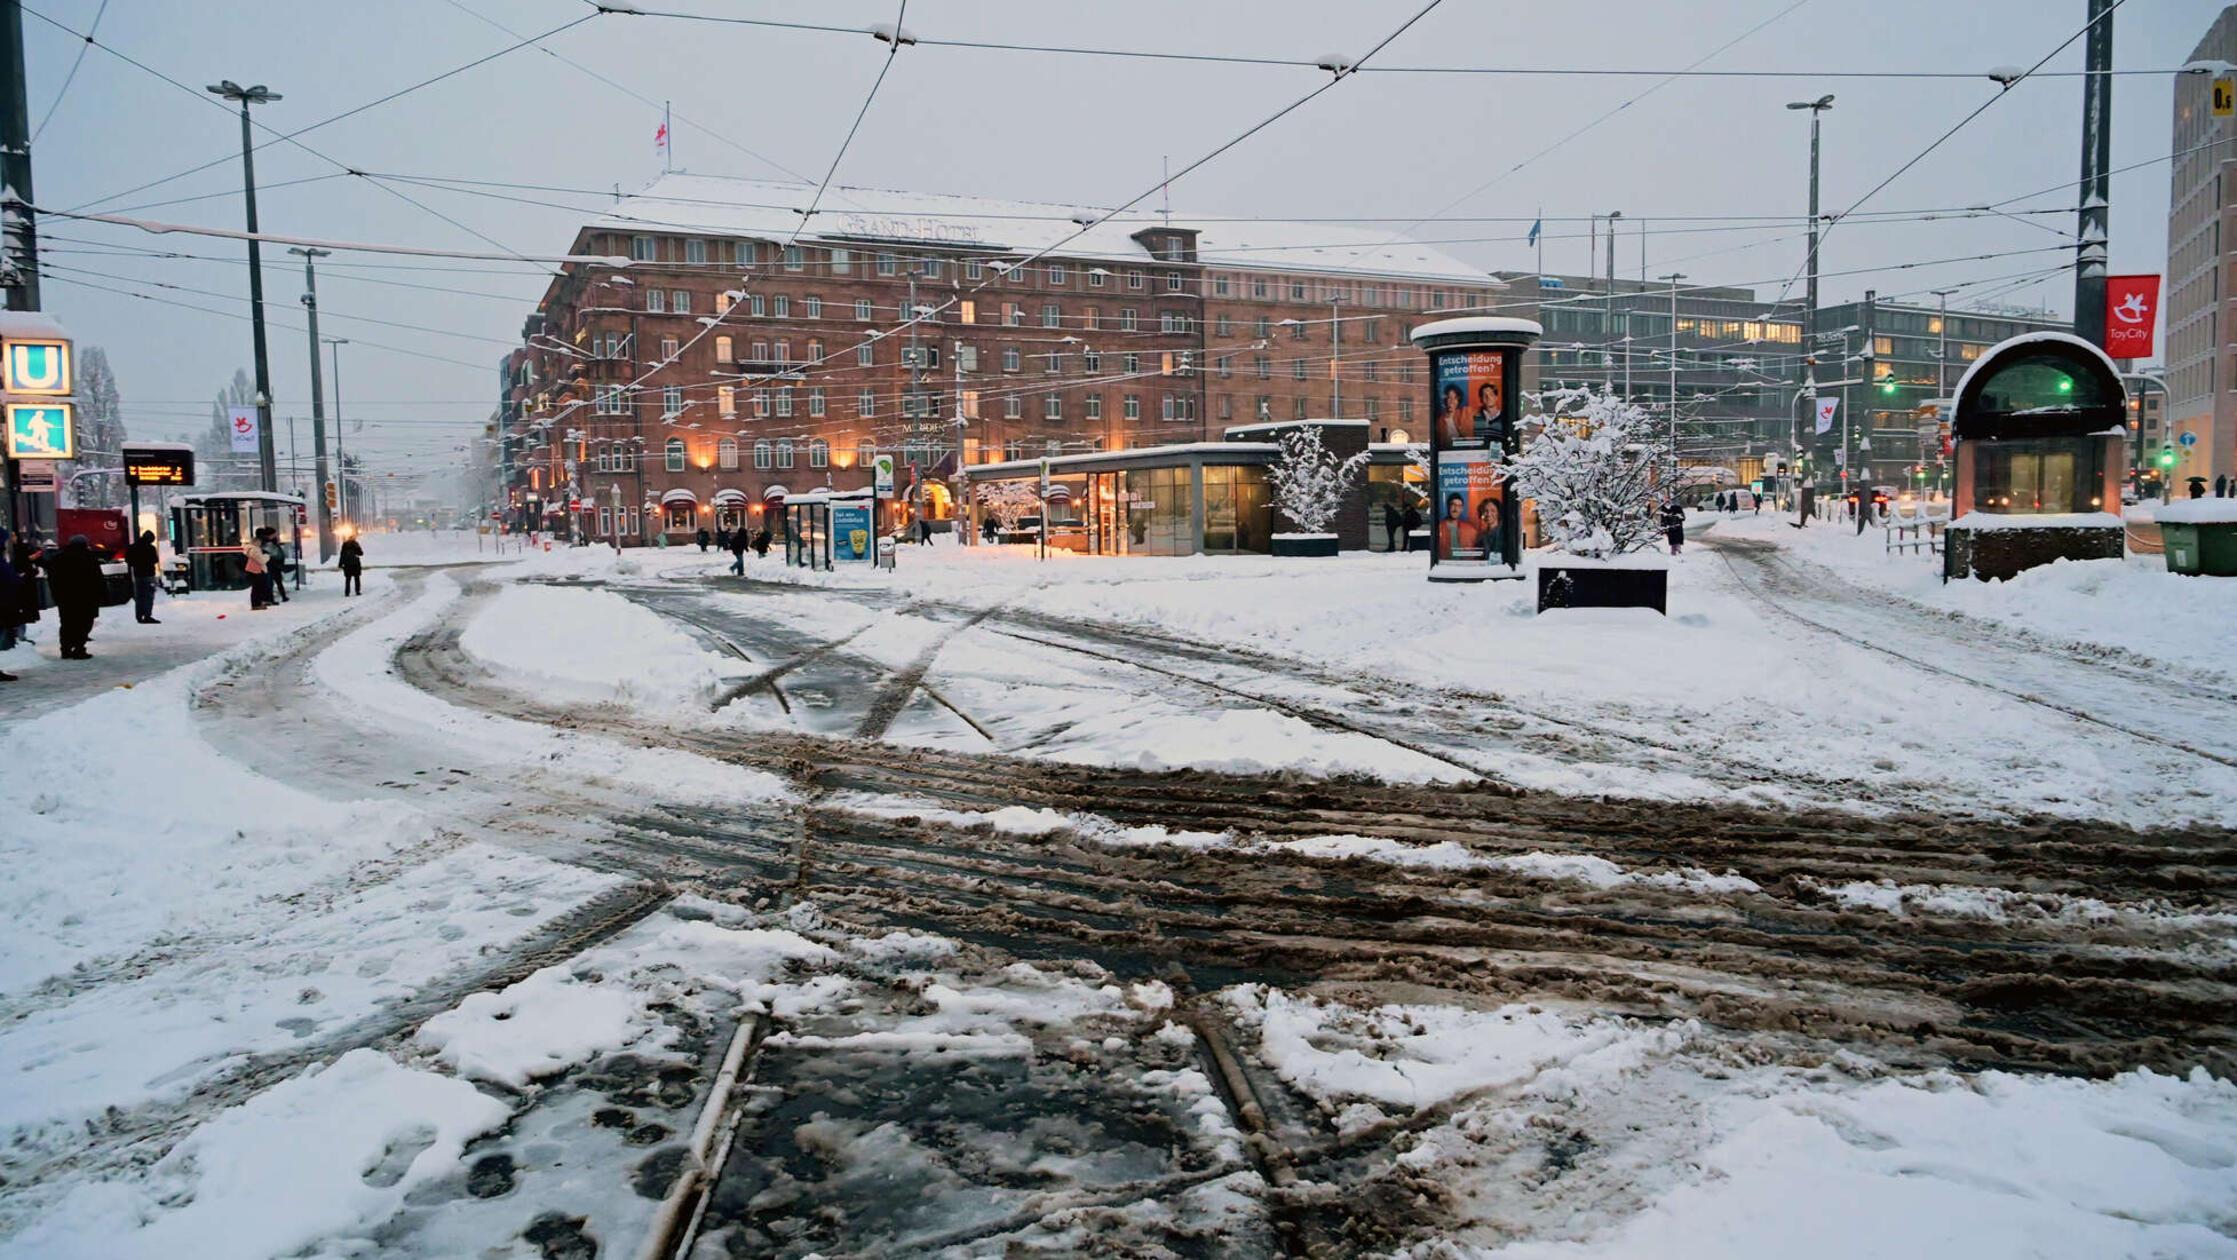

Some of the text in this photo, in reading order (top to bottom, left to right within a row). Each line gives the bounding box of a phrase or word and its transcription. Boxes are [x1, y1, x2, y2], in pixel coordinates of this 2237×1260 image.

[2111, 328, 2148, 341] ToyCity
[1438, 354, 1503, 365] Entscheidung
[15, 346, 59, 388] U
[1444, 364, 1495, 376] getroffen?
[1438, 466, 1499, 476] Entscheidun
